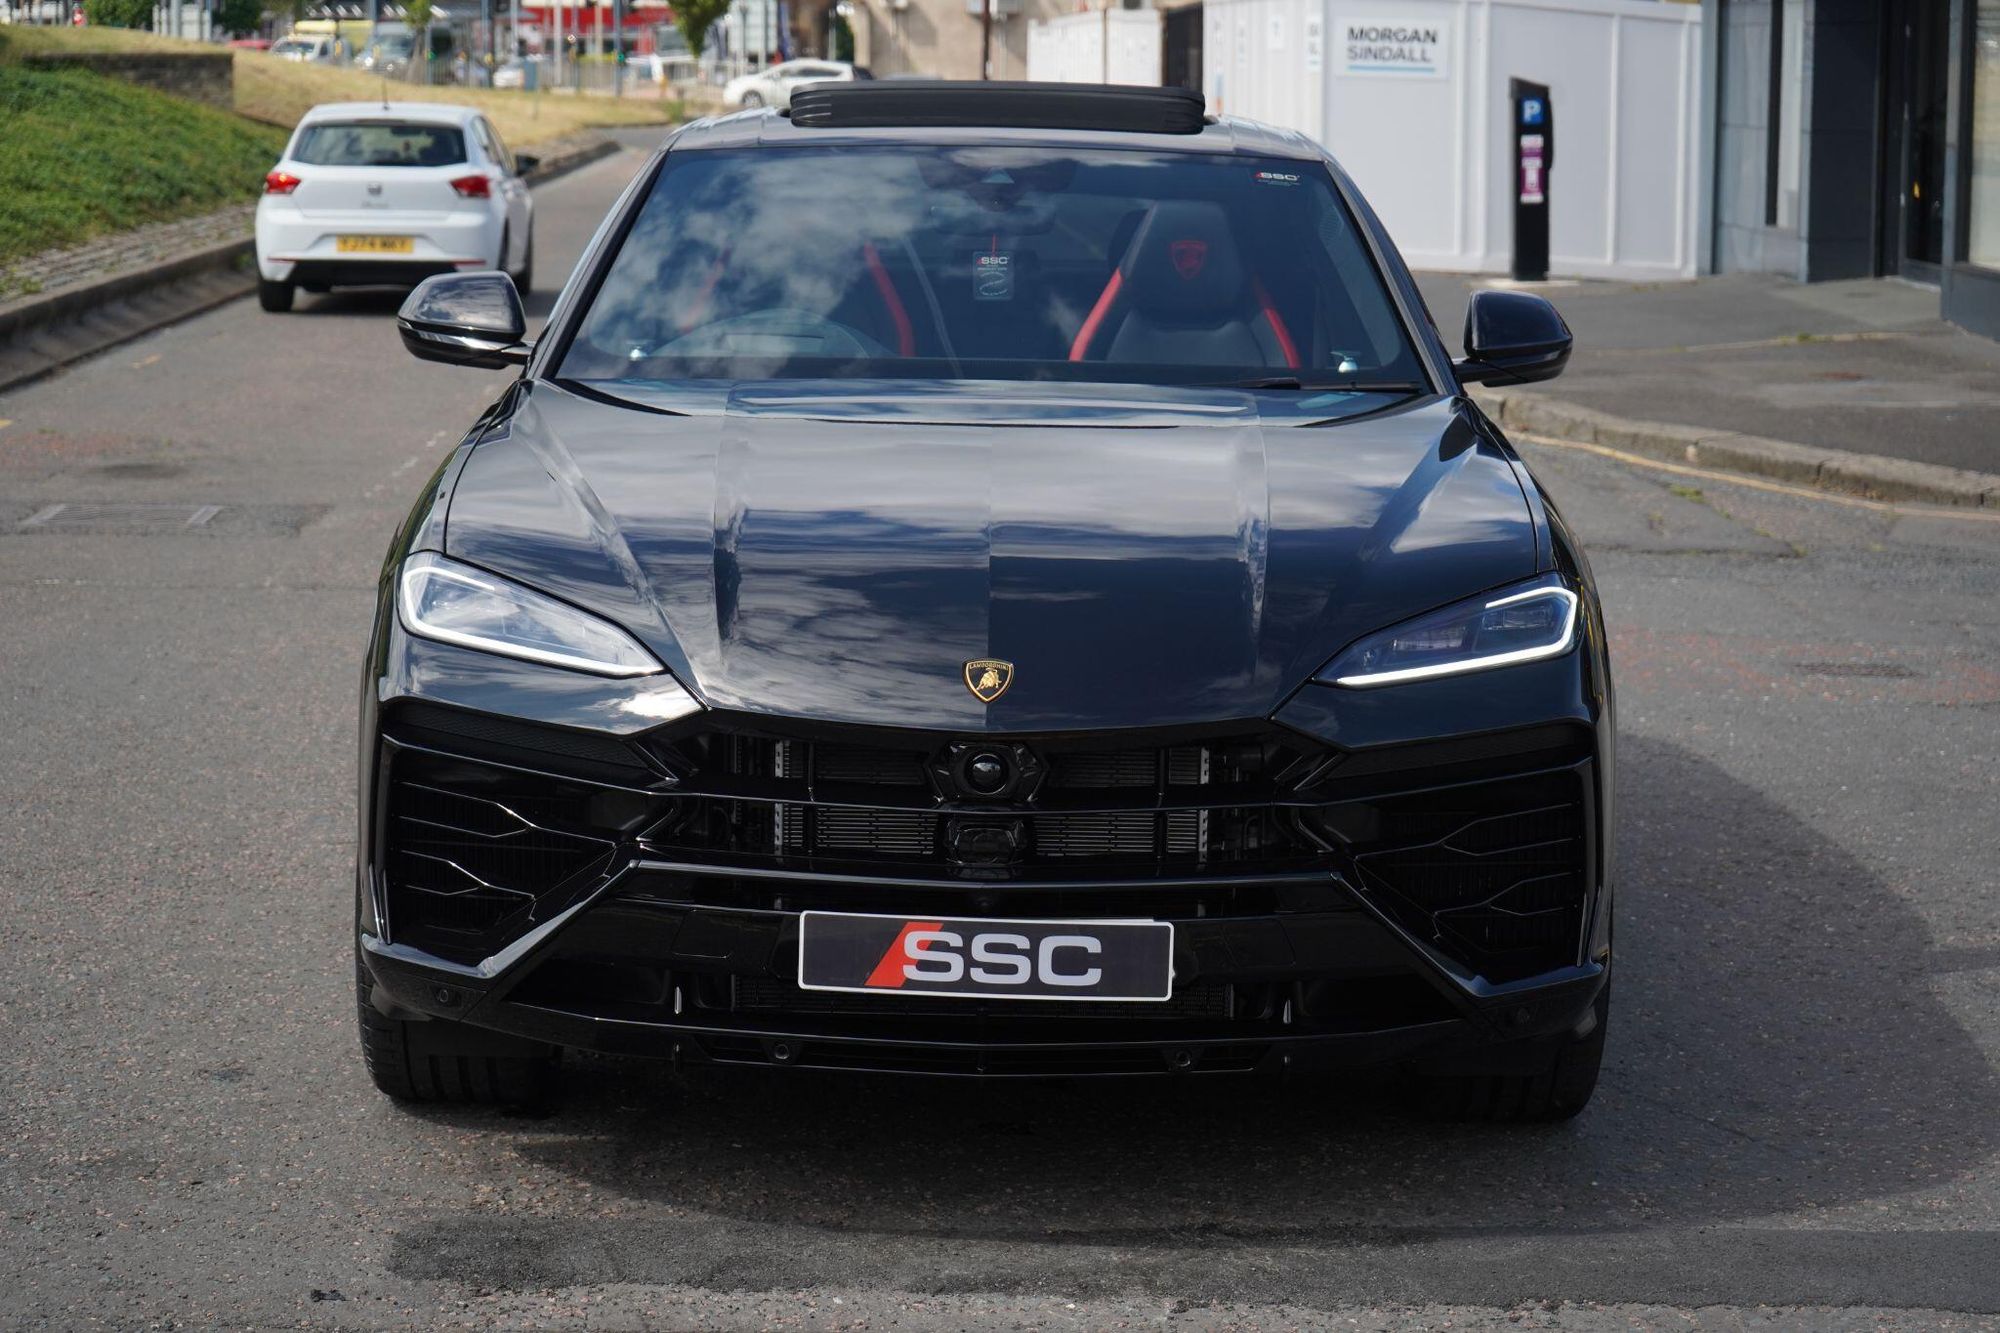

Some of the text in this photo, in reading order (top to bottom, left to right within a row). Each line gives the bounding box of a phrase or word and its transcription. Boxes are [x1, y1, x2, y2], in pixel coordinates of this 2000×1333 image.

[1347, 27, 1437, 43] MORGAN
[1347, 46, 1432, 62] SINDALL
[1523, 100, 1541, 122] P
[981, 256, 1008, 265] SSC
[902, 931, 1102, 986] SSC
